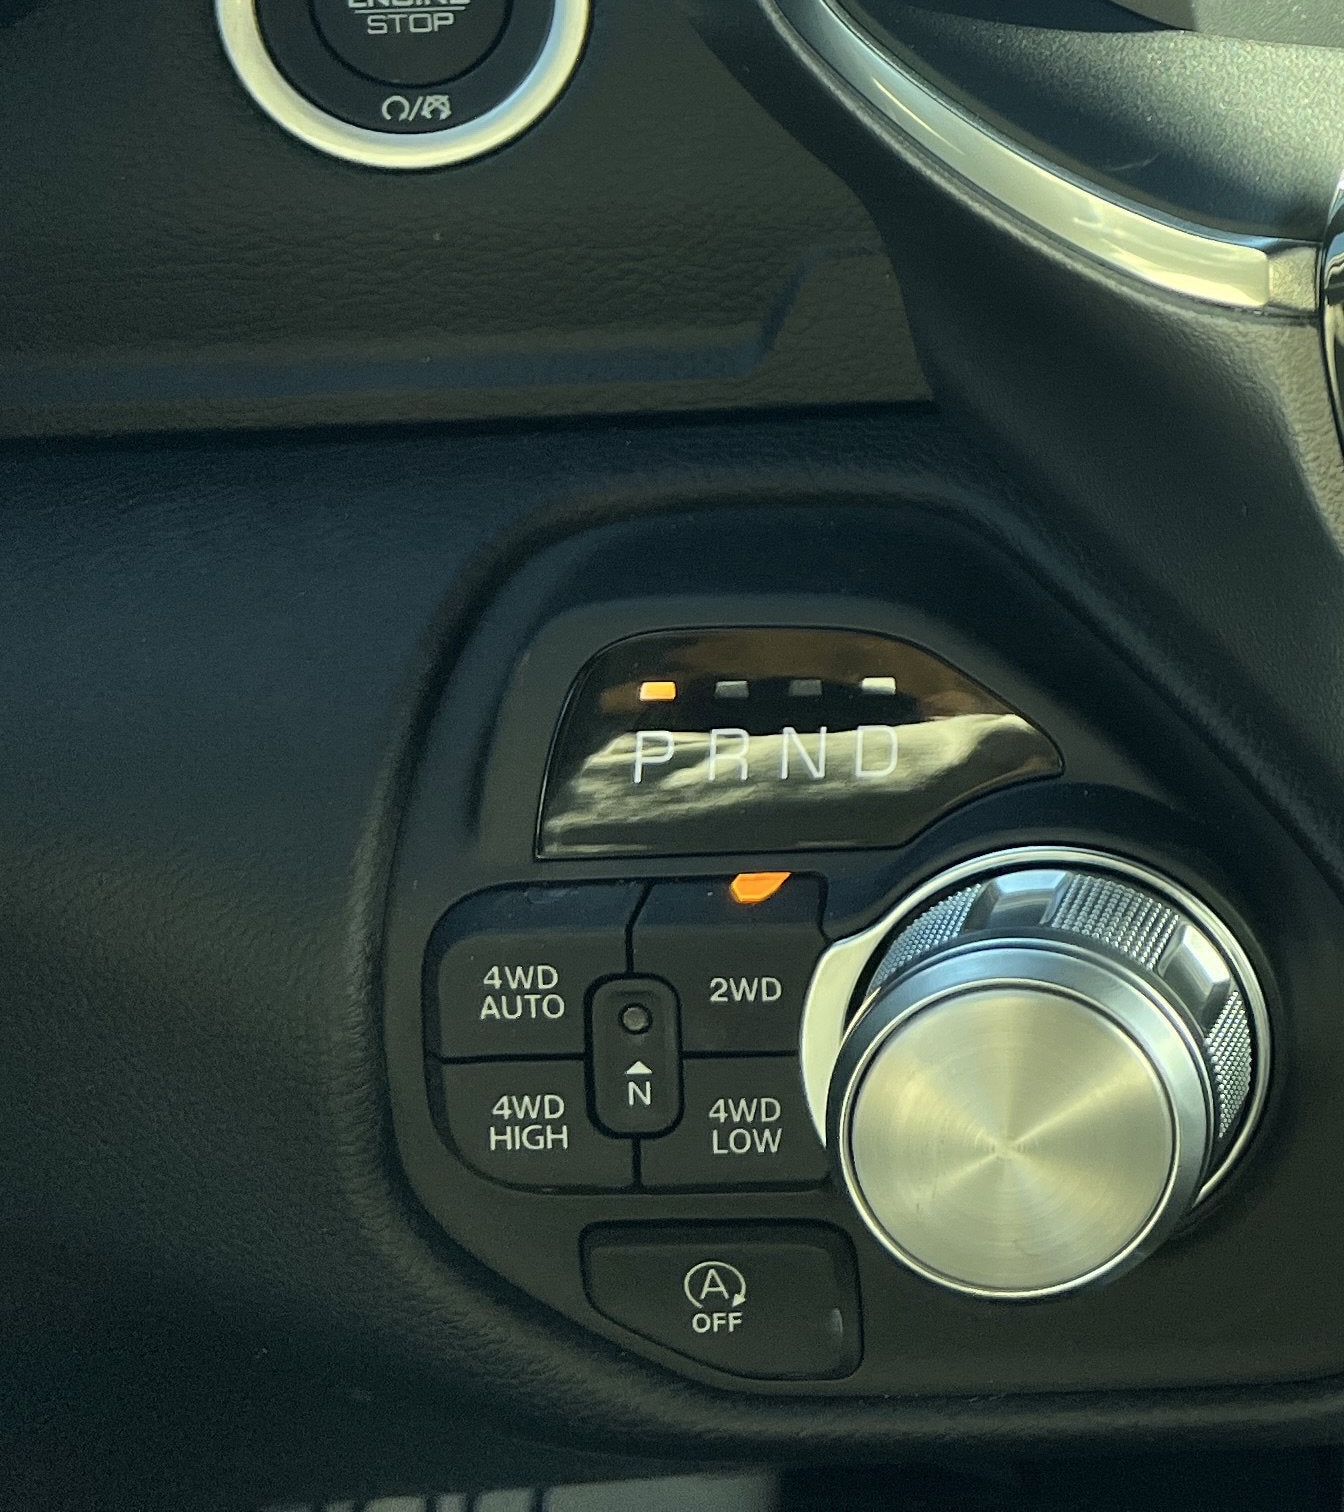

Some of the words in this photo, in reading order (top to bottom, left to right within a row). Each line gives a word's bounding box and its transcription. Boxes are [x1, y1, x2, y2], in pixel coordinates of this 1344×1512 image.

[367, 12, 455, 35] STOP
[632, 729, 675, 785] P
[708, 727, 749, 782] R
[781, 725, 829, 780] N
[854, 724, 899, 779] D
[483, 964, 560, 991] 4WD
[709, 976, 782, 1002] 2WD
[480, 994, 565, 1020] AUTO
[628, 1081, 652, 1106] N
[491, 1094, 566, 1120] 4WD
[708, 1097, 781, 1124] 4WD
[489, 1124, 569, 1151] HIGH
[712, 1127, 782, 1154] LOW
[692, 1311, 743, 1334] OFF
